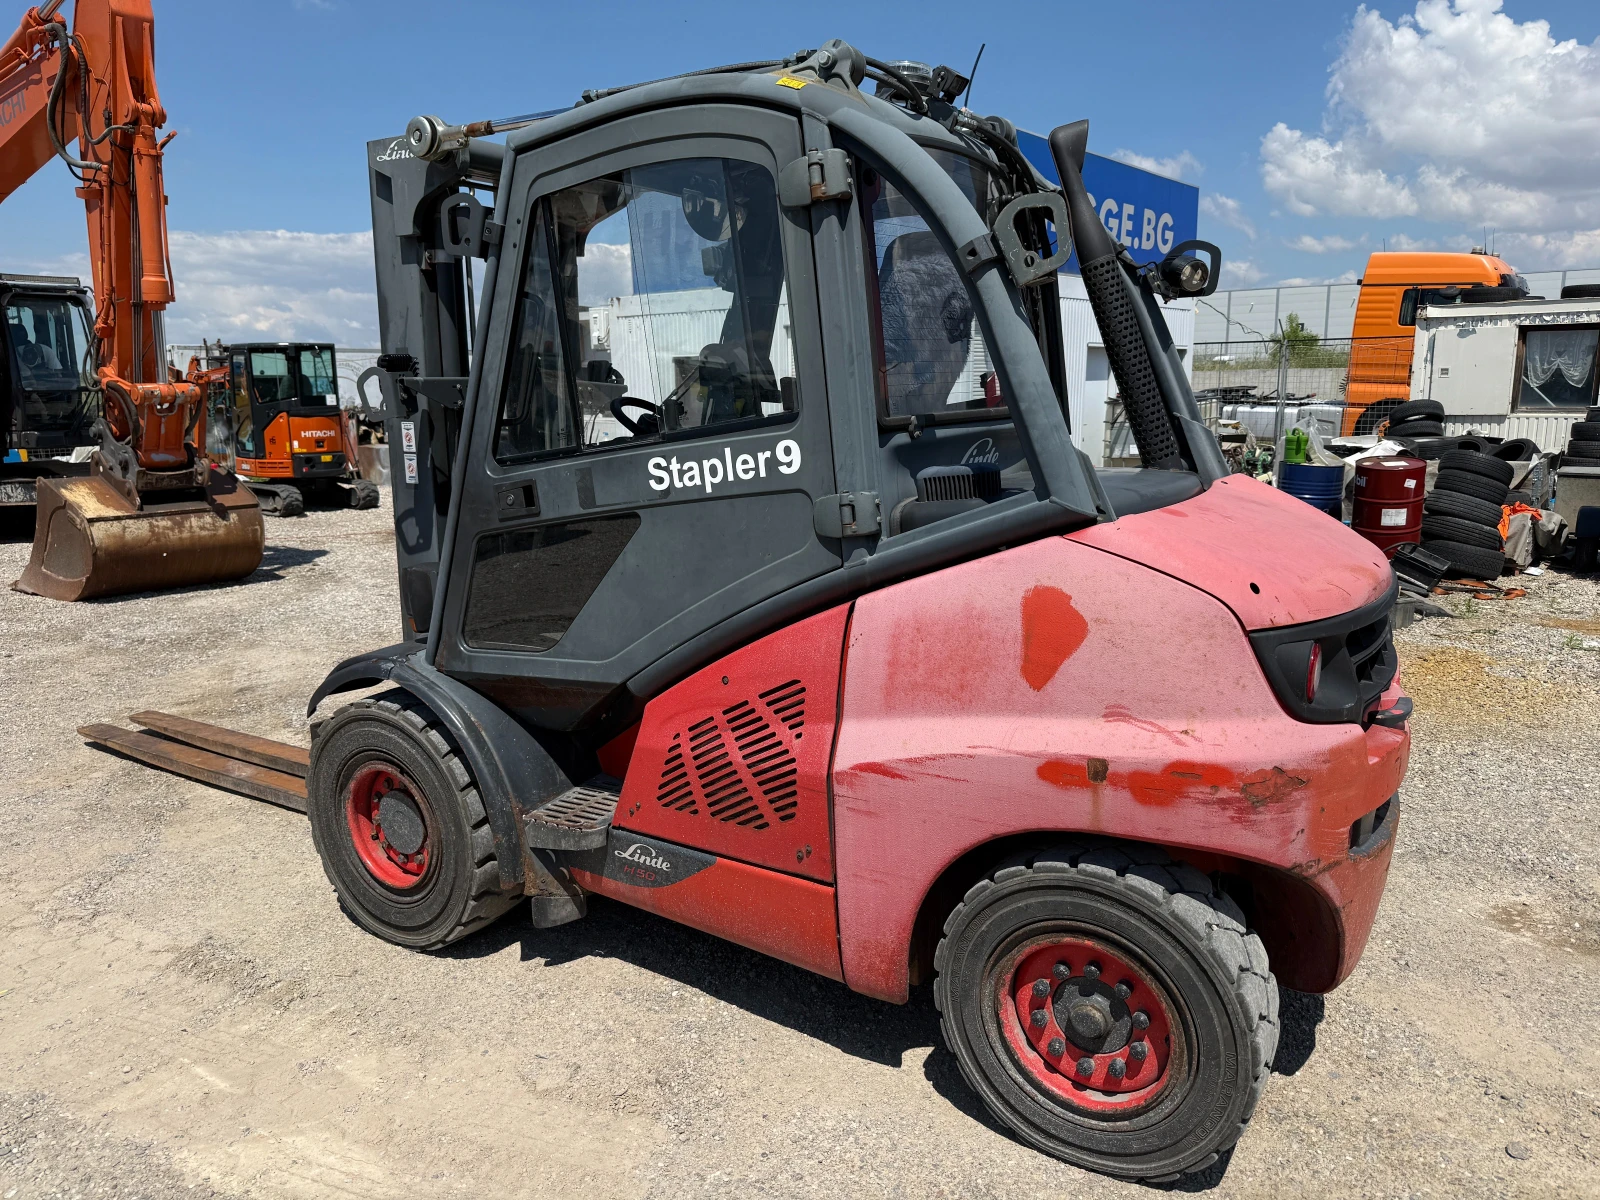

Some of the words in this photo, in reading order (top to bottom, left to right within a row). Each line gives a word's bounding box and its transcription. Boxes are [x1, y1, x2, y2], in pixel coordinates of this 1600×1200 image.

[0, 90, 26, 127] CHI
[301, 430, 335, 438] HITACHI
[647, 447, 772, 493] Stapler
[775, 439, 802, 475] 9
[614, 843, 671, 872] Linde
[950, 907, 991, 1003] MARANGONI
[1181, 1050, 1238, 1149] MARANGONI
